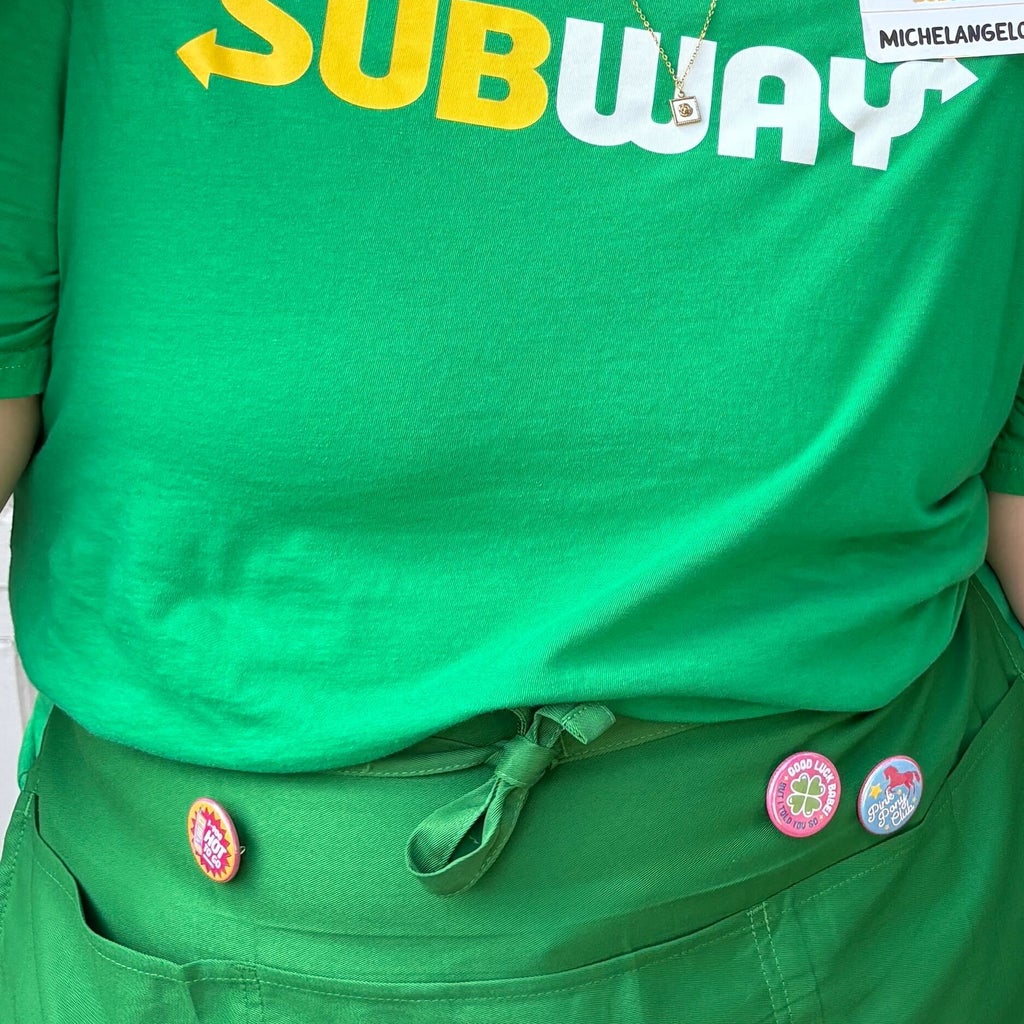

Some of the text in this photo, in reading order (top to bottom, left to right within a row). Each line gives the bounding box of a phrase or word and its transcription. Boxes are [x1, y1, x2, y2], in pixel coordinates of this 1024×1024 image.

[787, 758, 813, 777] GOOD
[813, 759, 835, 783] LUCK
[776, 781, 787, 799] BUT
[780, 804, 793, 825] TOLD
[867, 789, 895, 823] Pink
[878, 793, 908, 828] Pony
[891, 800, 915, 826] Club
[807, 816, 819, 828] SO
[203, 829, 228, 859] HOT
[203, 843, 222, 869] TO GO
